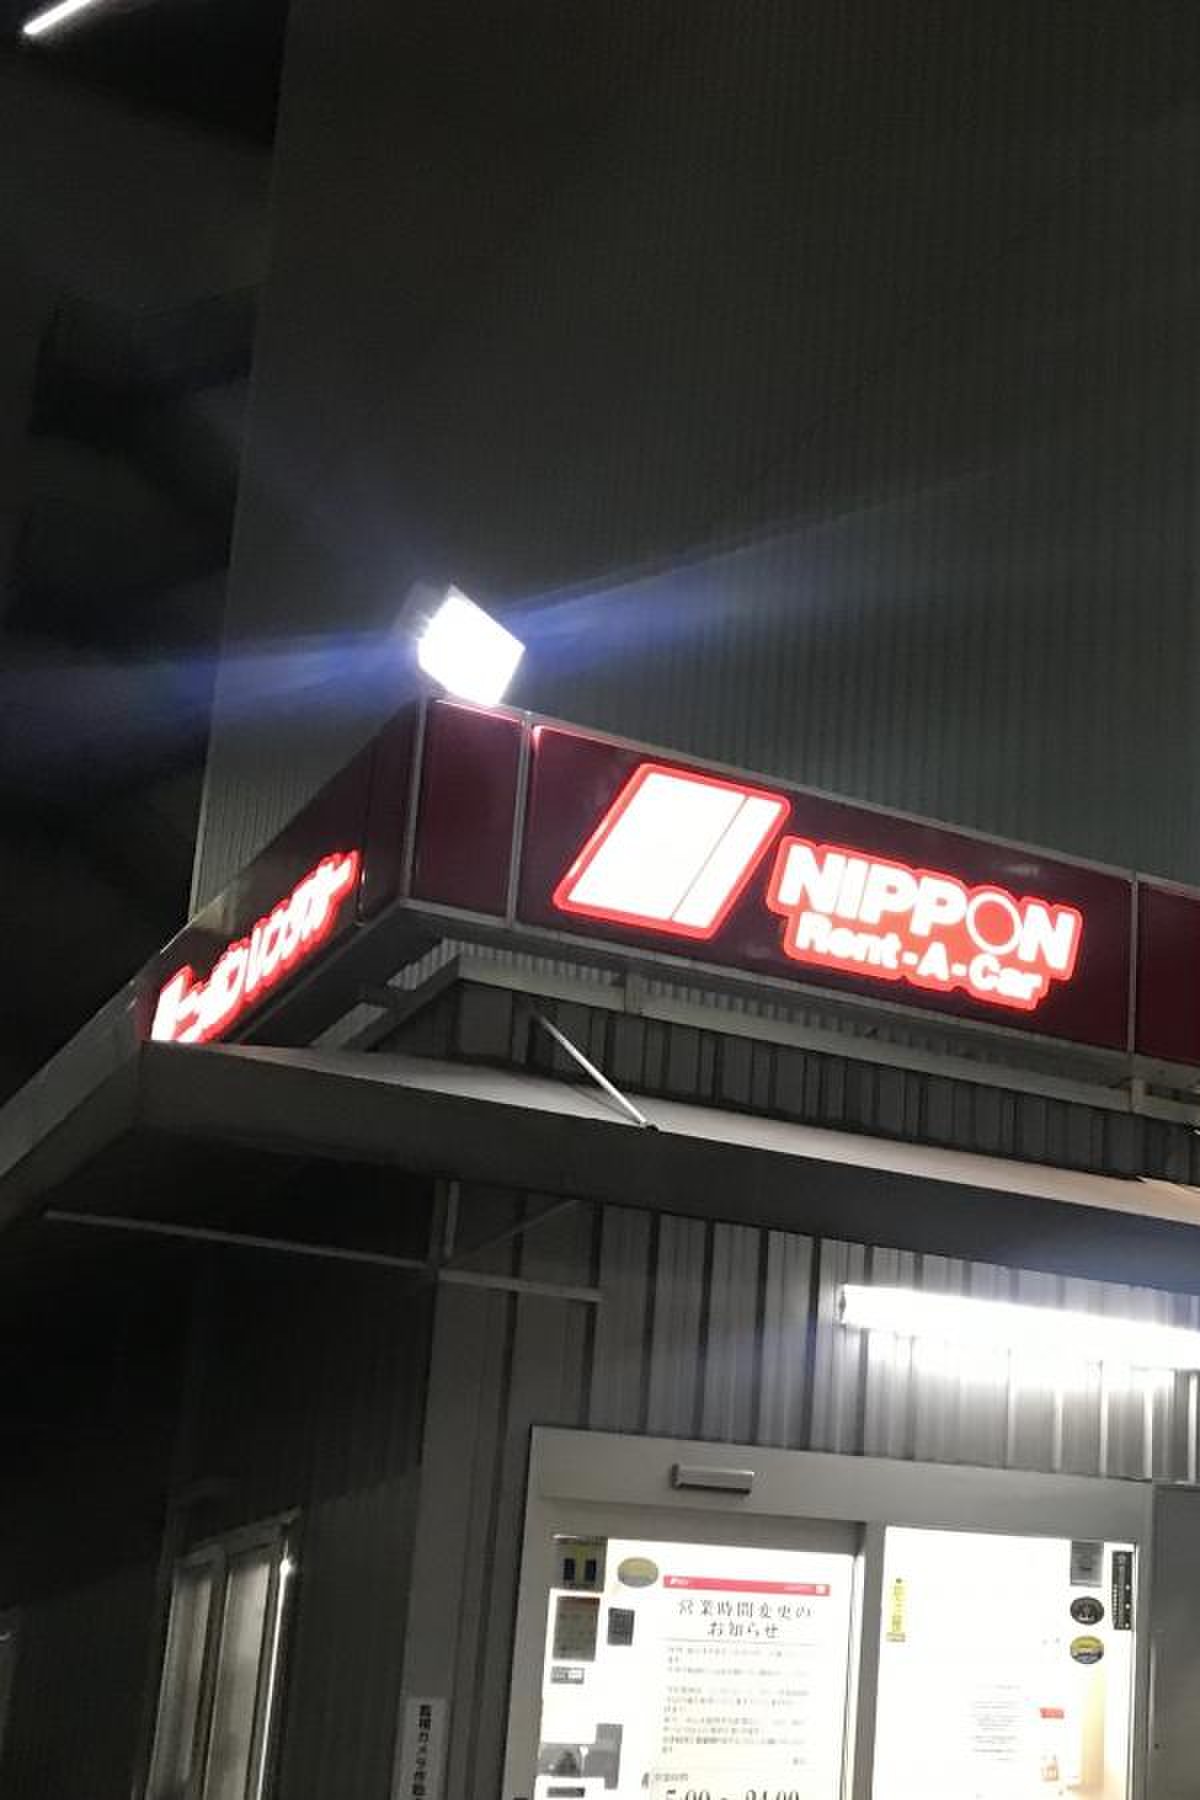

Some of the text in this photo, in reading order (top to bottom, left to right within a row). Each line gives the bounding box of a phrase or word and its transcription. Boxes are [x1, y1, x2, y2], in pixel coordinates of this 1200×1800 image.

[777, 843, 1076, 970] NIPPON
[795, 911, 1043, 1000] Rent-A-Car
[707, 1620, 780, 1639] お知らせ
